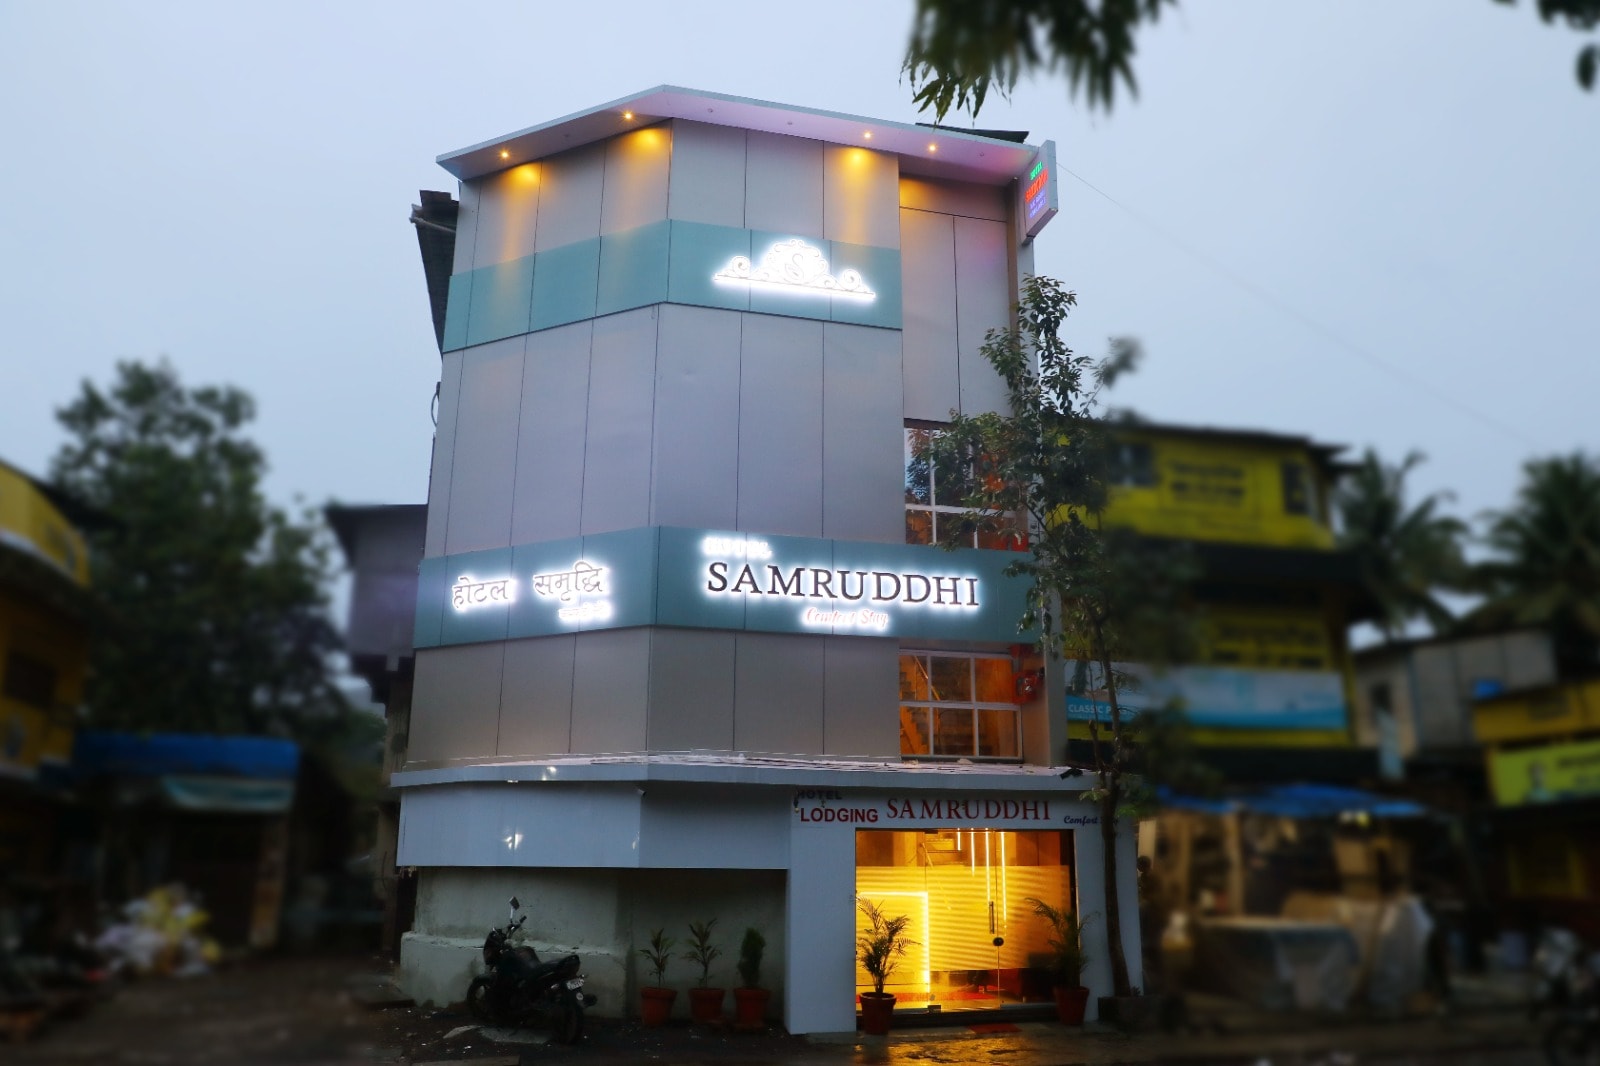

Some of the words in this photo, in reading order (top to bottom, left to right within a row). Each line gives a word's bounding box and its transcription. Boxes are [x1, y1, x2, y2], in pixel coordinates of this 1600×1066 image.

[453, 576, 509, 608] होटल
[534, 561, 603, 601] समृद्धि
[707, 561, 980, 606] SAMRUDDHI
[1068, 704, 1103, 714] CLASSIC
[797, 790, 843, 800] HOTEL
[800, 808, 879, 823] LODGING
[887, 798, 1051, 820] SAMRUDDHI
[1063, 815, 1098, 826] Comfort
